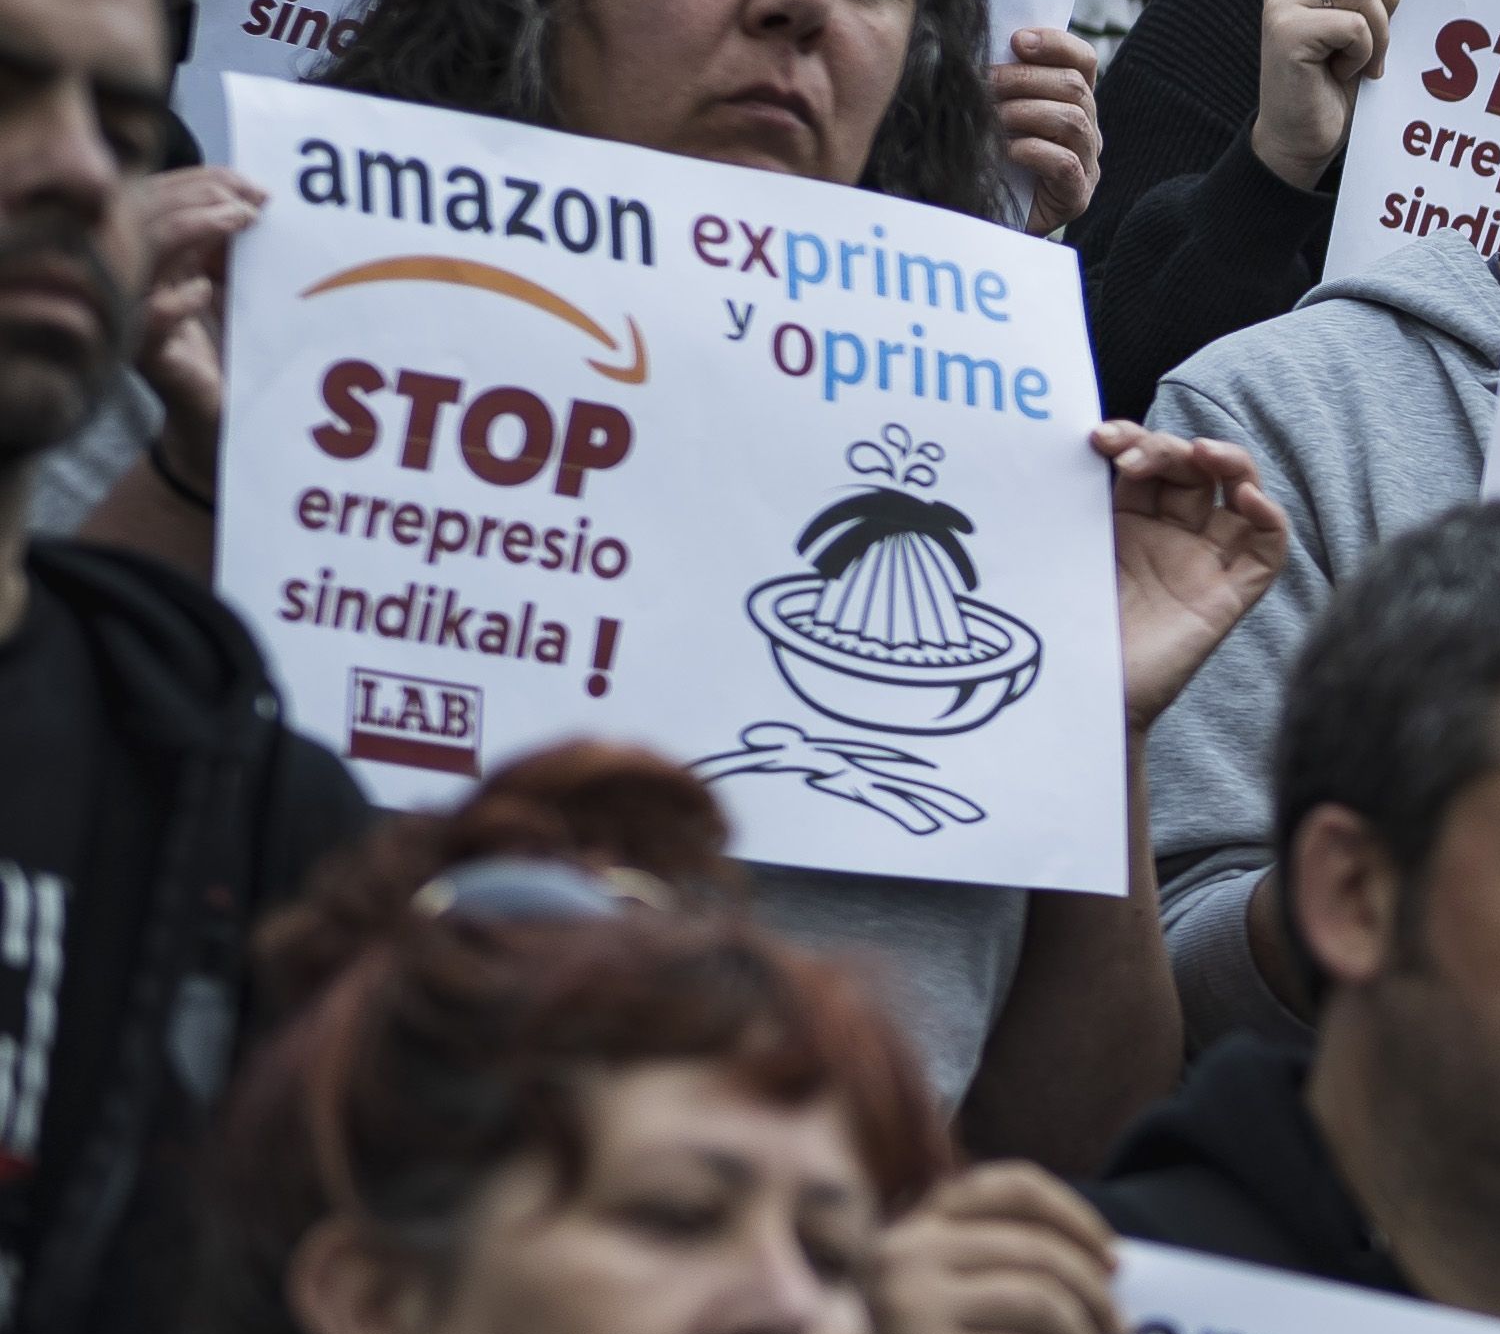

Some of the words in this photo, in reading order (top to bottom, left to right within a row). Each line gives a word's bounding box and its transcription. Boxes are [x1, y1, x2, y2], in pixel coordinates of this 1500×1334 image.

[297, 137, 655, 267] amazon
[691, 211, 1012, 322] exprime
[722, 299, 756, 341] y
[772, 317, 1051, 420] oprime
[308, 359, 631, 498] STOP
[296, 485, 630, 580] errepresio
[356, 678, 476, 744] LAB
